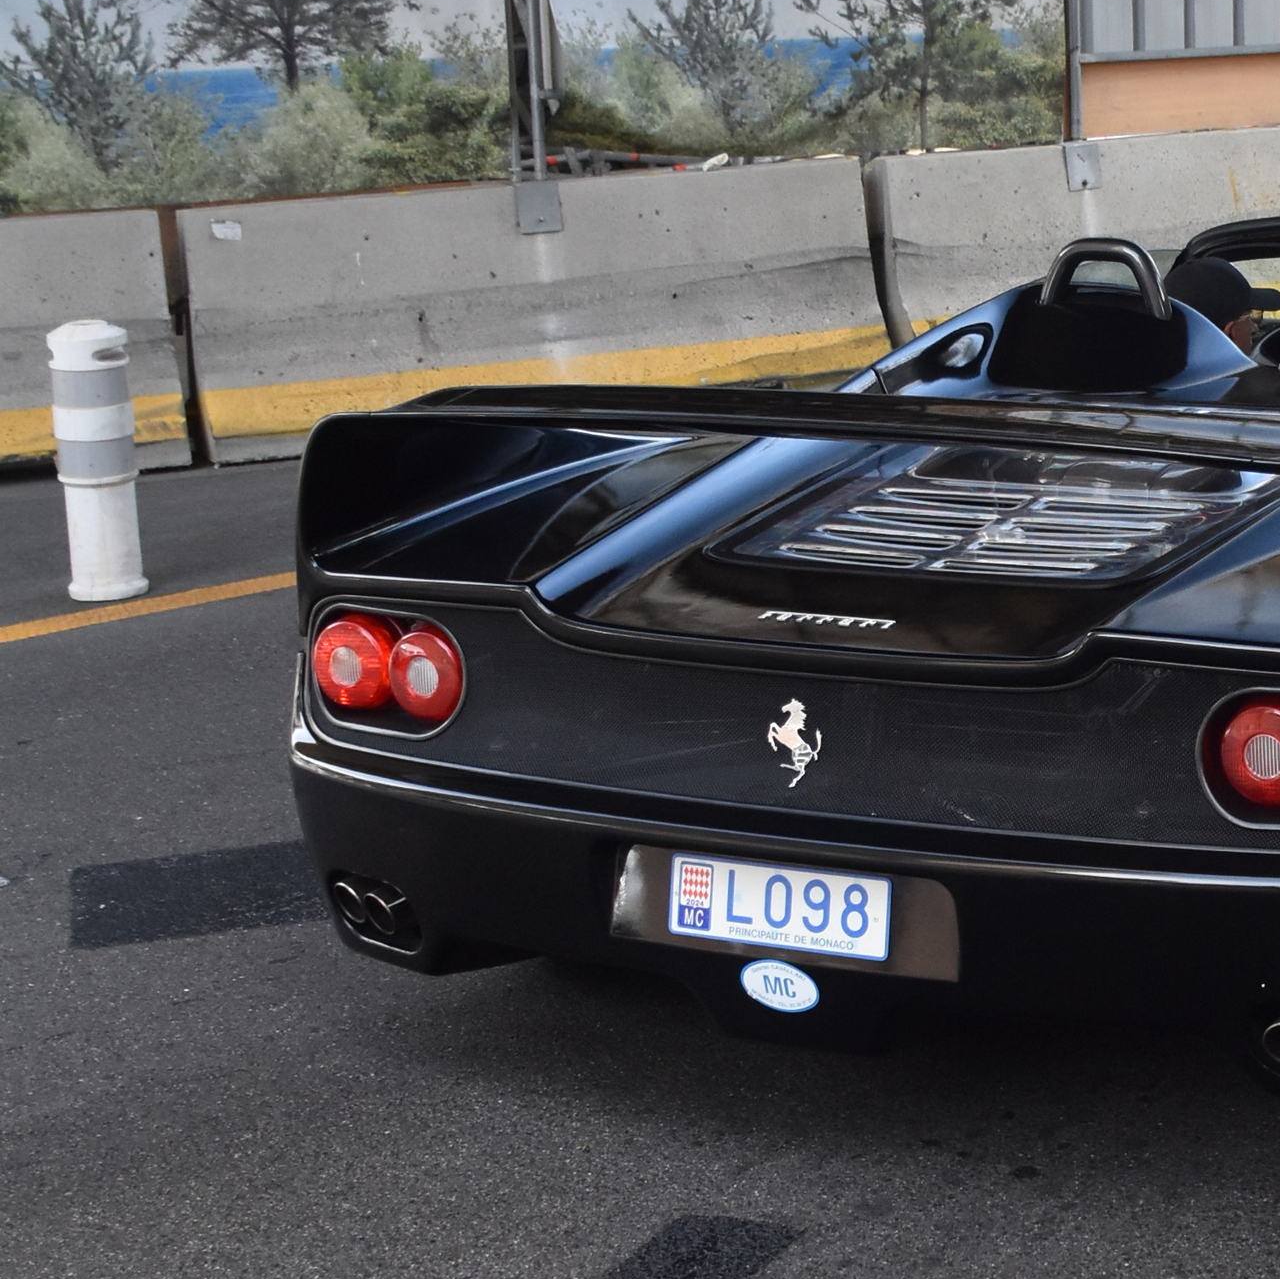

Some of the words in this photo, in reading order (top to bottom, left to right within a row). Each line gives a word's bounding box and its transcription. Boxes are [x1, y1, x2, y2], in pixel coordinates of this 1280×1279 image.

[686, 898, 704, 908] 2024
[726, 869, 869, 939] L098
[683, 908, 704, 927] MC
[729, 926, 790, 943] PRINCIPAUTE
[794, 935, 808, 945] DE
[810, 937, 855, 951] MONACO
[763, 974, 797, 998] MC
